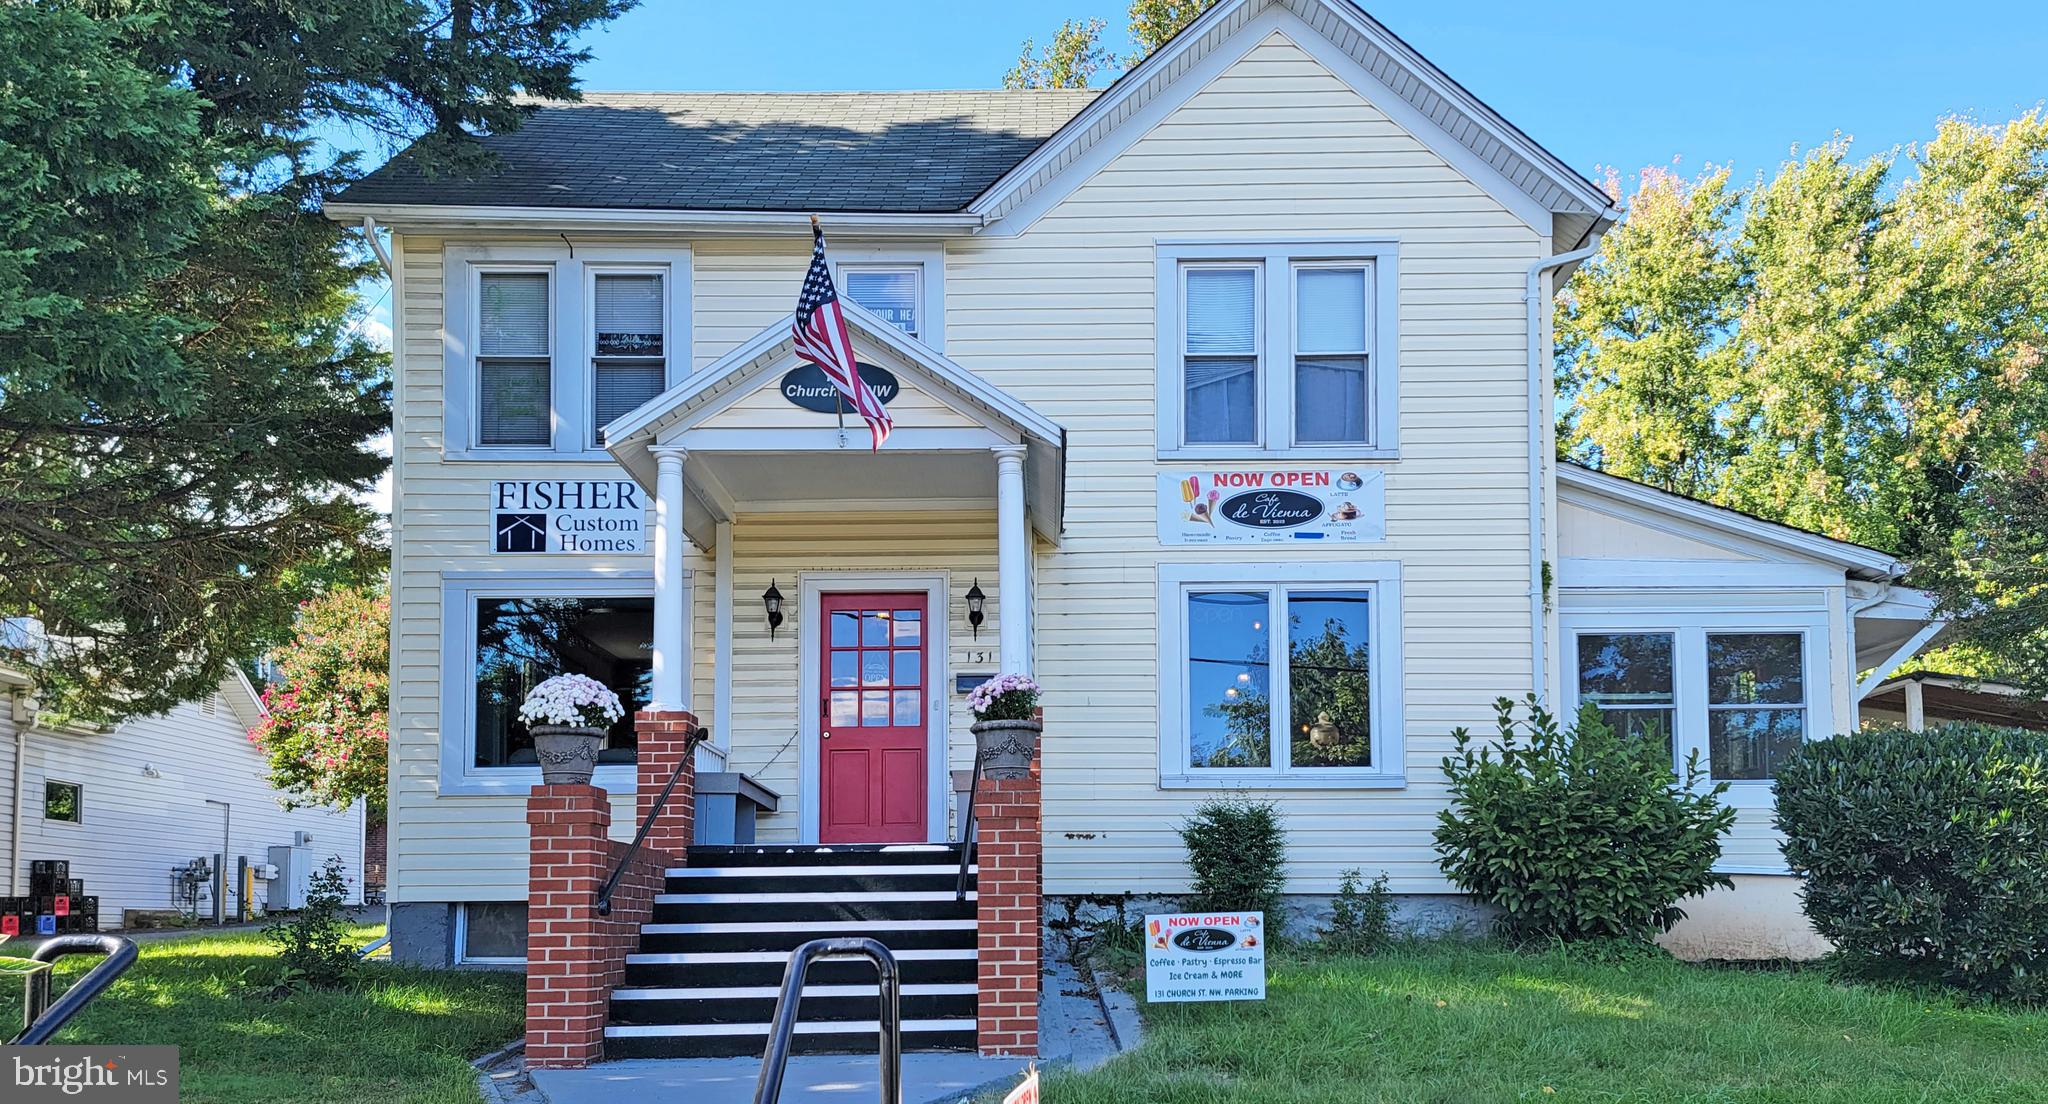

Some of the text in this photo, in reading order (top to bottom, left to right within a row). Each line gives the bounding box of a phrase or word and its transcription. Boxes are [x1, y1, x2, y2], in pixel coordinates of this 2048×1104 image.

[786, 384, 837, 397] Church
[1213, 471, 1330, 488] NOW OPEN
[495, 481, 640, 510] FISHER
[1255, 493, 1280, 507] Cafe
[1232, 502, 1312, 519] de Vienna
[555, 514, 639, 532] Custom
[967, 651, 992, 663] 131
[1168, 916, 1240, 926] NOW OPEN
[1194, 929, 1209, 938] Cafe
[1180, 935, 1229, 947] de Vienna
[1150, 956, 1262, 968] Coffee Pastry Espresso Bar
[1169, 970, 1243, 980] Ice Cream & MORE
[1155, 990, 1165, 998] 131
[1166, 989, 1196, 998] CHURCH
[1225, 988, 1259, 996] PARKING
